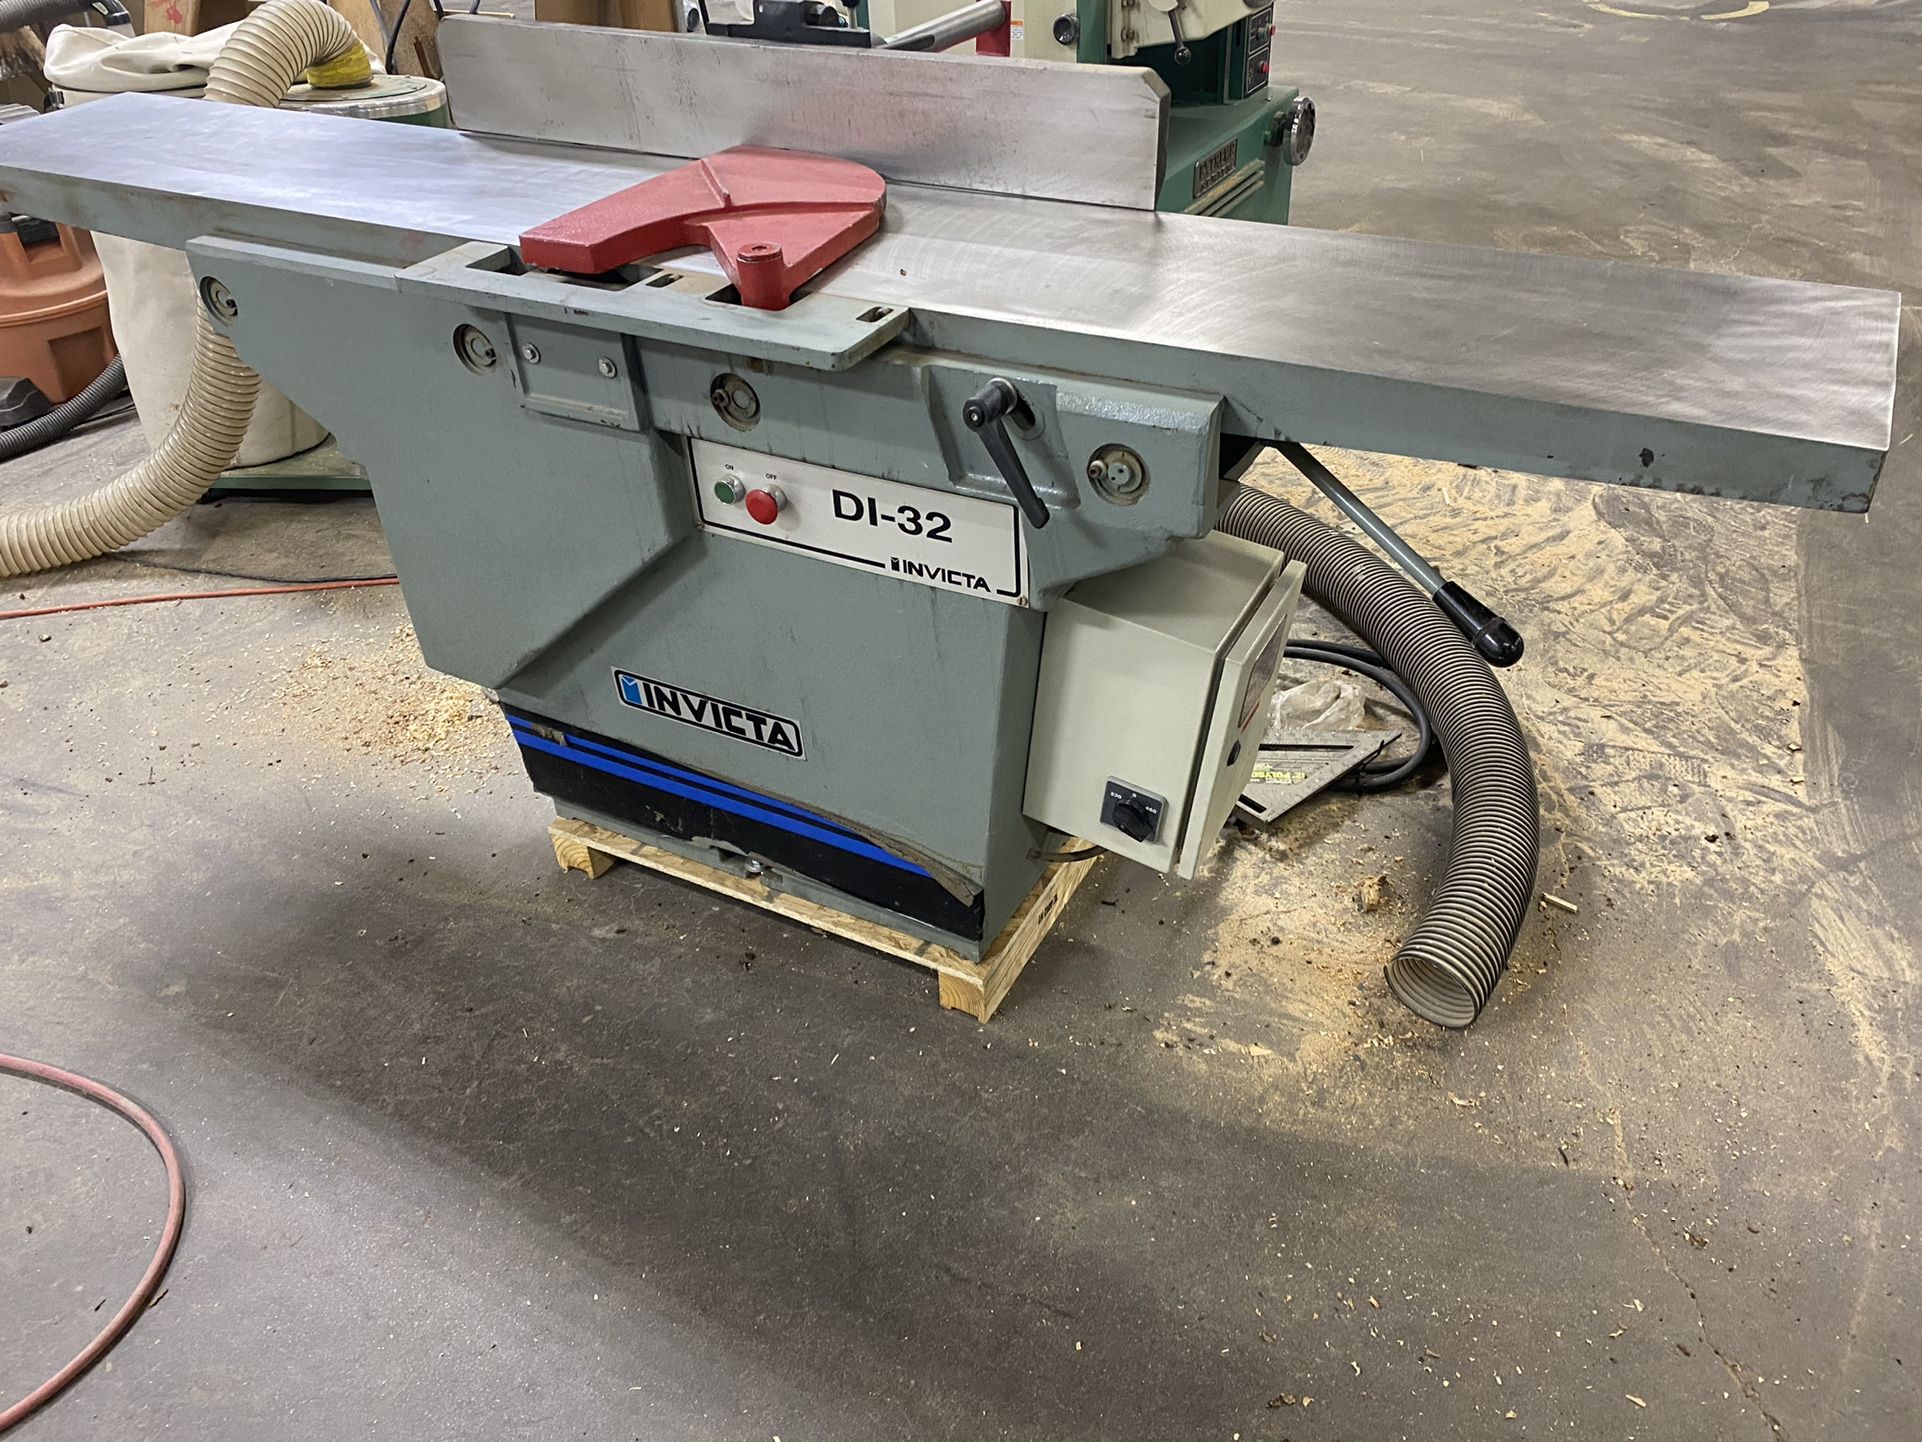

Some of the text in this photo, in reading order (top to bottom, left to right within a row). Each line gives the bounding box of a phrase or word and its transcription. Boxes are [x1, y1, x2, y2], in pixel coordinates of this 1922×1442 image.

[725, 463, 734, 471] ON
[765, 472, 777, 480] OFF
[832, 489, 953, 543] DI-32
[902, 559, 991, 592] INVICTA
[642, 682, 797, 752] INVICTA
